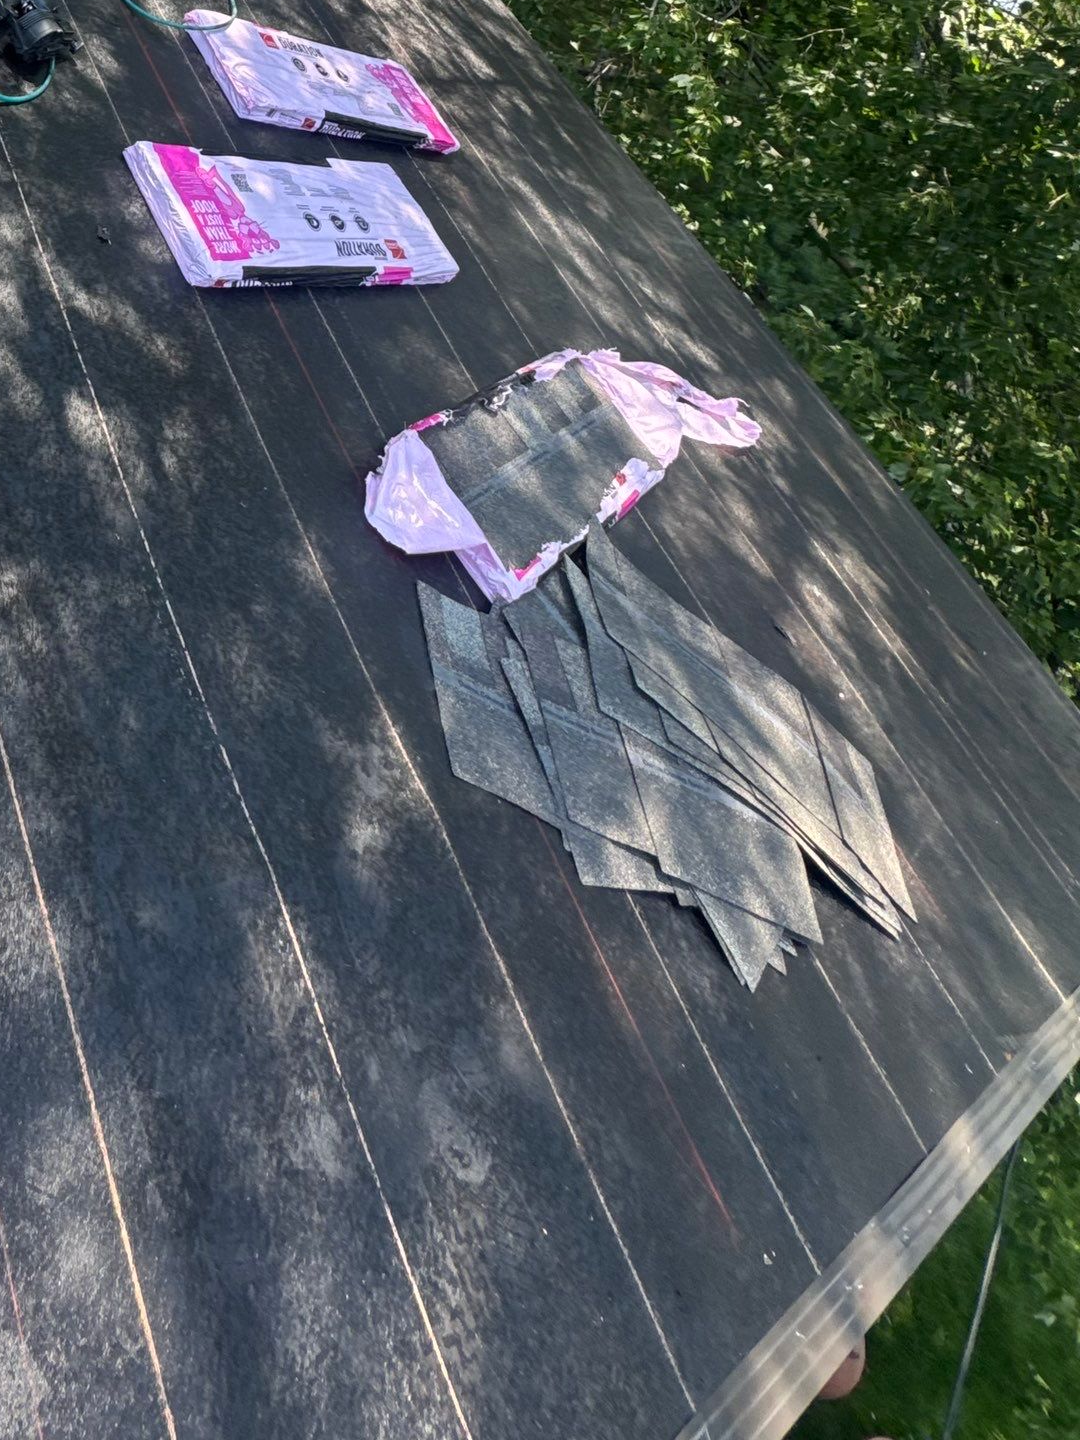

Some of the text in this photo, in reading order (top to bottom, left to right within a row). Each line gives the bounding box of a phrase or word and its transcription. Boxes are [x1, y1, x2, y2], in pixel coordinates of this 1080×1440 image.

[277, 36, 324, 58] DURATION
[190, 200, 220, 213] ROOF
[196, 214, 225, 226] JUST A
[202, 227, 234, 240] THAN
[210, 240, 242, 254] MORE
[334, 240, 387, 257] DURATION
